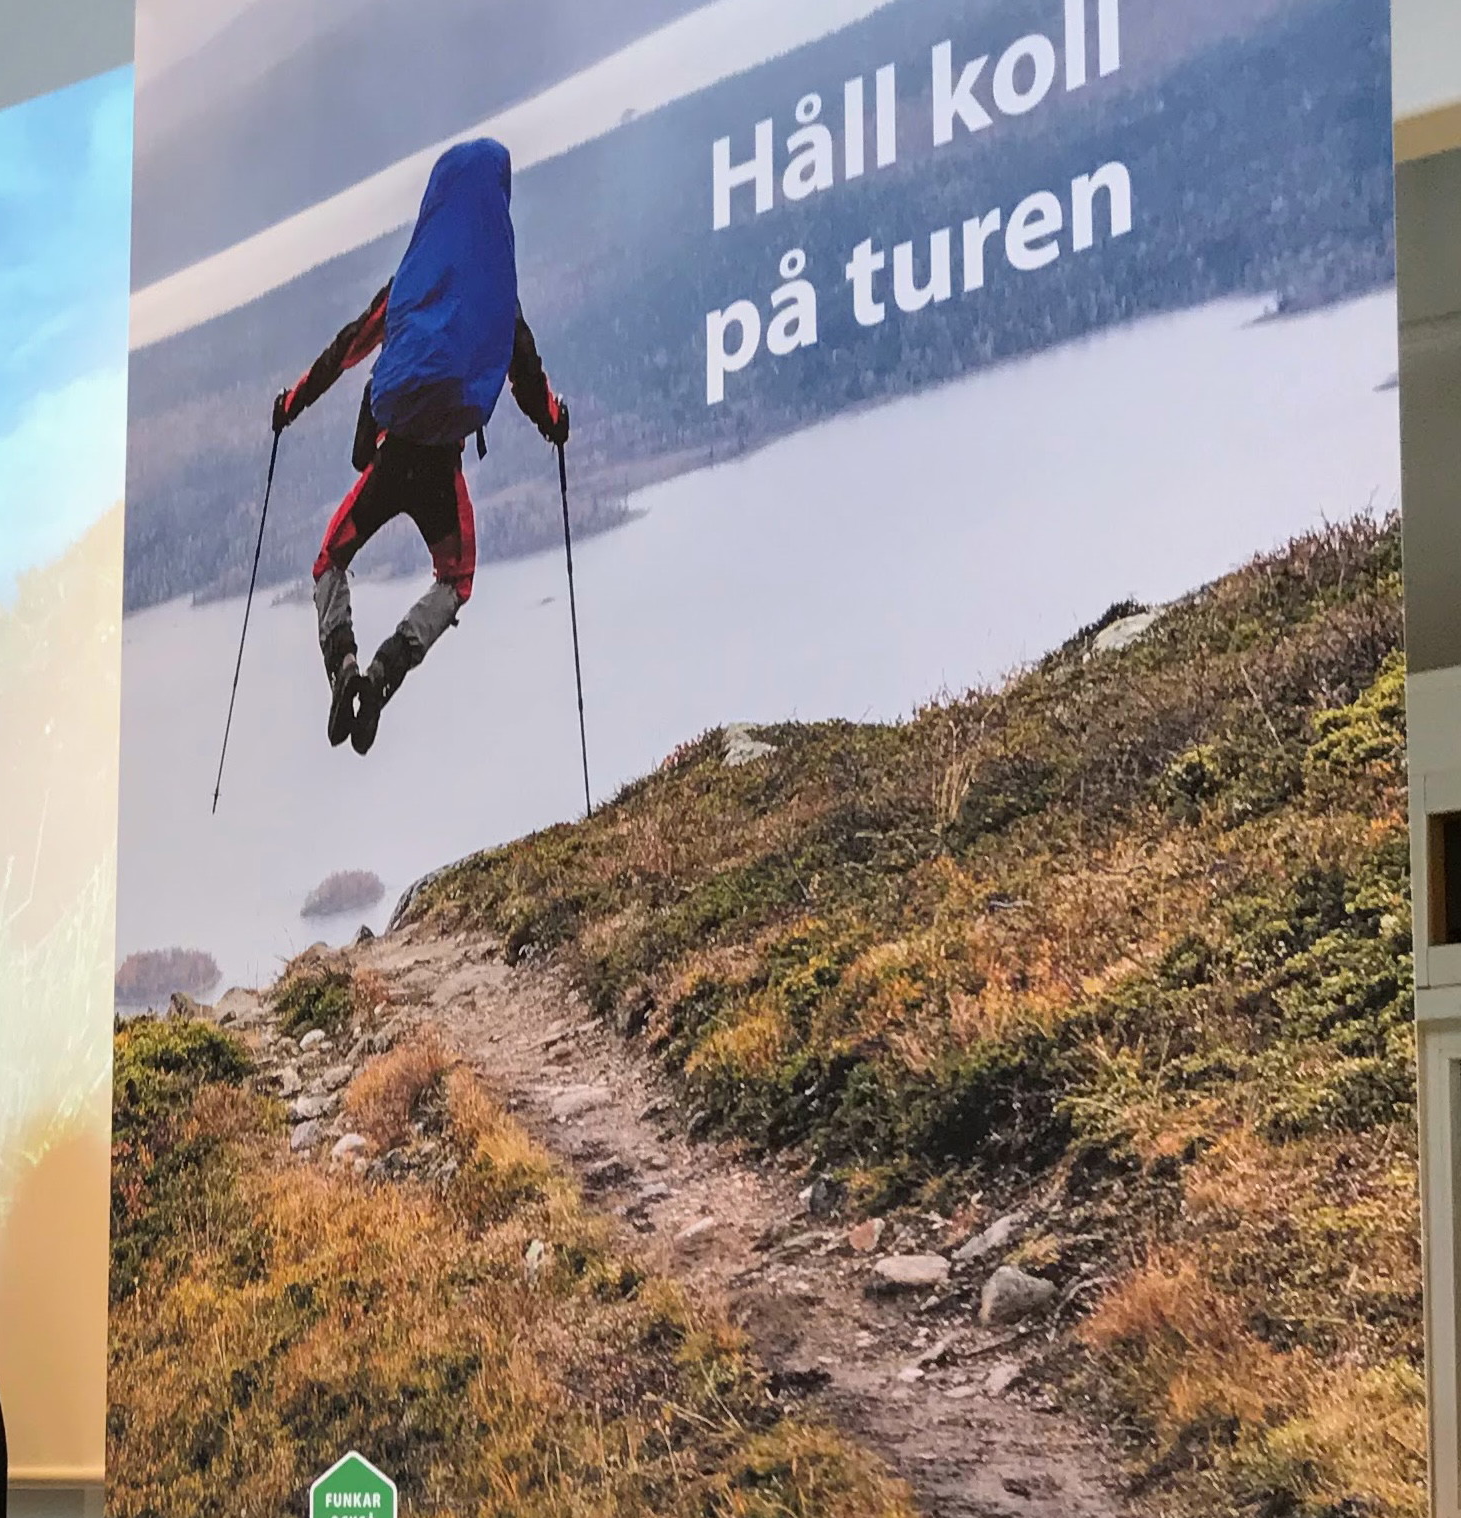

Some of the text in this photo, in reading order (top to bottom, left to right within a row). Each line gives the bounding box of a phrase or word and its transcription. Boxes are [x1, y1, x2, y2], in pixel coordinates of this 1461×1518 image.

[712, 0, 1120, 231] Håll koll
[706, 160, 1132, 405] på turen
[325, 1492, 381, 1508] FUNKAR
